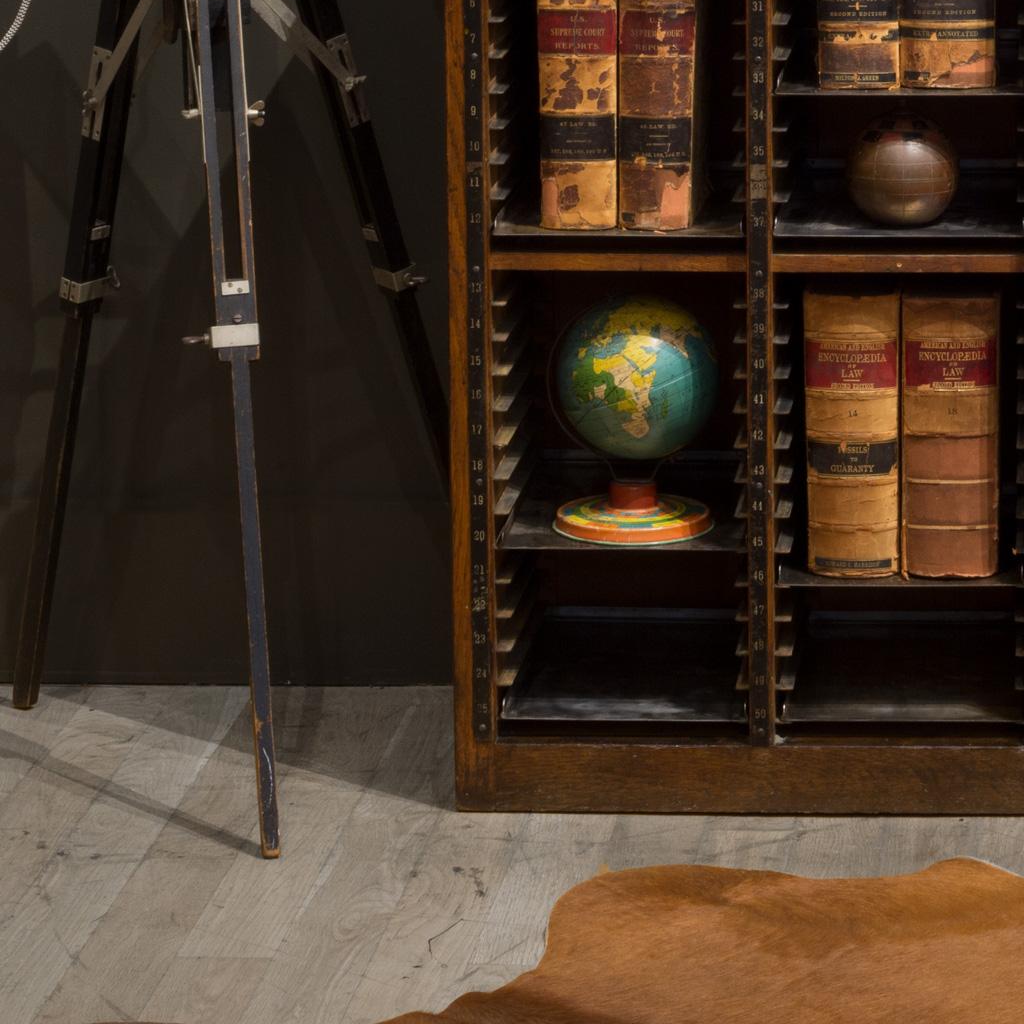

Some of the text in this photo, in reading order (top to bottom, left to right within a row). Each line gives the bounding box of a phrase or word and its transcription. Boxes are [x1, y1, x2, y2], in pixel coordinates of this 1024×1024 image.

[752, 0, 763, 12] 31
[584, 28, 605, 36] COURT
[469, 32, 477, 44] 7
[752, 37, 764, 48] 32
[469, 69, 477, 80] 8
[753, 72, 764, 83] 33
[470, 105, 477, 116] 9
[752, 109, 764, 120] 34
[469, 140, 481, 151] 10
[753, 145, 764, 156] 35
[469, 176, 480, 187] 11
[469, 213, 481, 224] 12
[753, 216, 764, 228] 37
[471, 282, 483, 293] 13
[469, 318, 481, 329] 14
[470, 355, 482, 366] 15
[753, 358, 765, 370] 40
[841, 369, 864, 378] LAW
[943, 368, 964, 377] LAW
[471, 389, 482, 400] 16
[753, 393, 764, 404] 41
[471, 424, 482, 435] 17
[752, 430, 763, 441] 42
[472, 459, 483, 471] 18
[753, 465, 765, 476] 43
[831, 464, 874, 472] GUARANTY
[472, 494, 484, 506] 19
[474, 530, 486, 541] 20
[752, 536, 763, 547] 45
[753, 570, 764, 581] 46
[753, 604, 764, 615] 47
